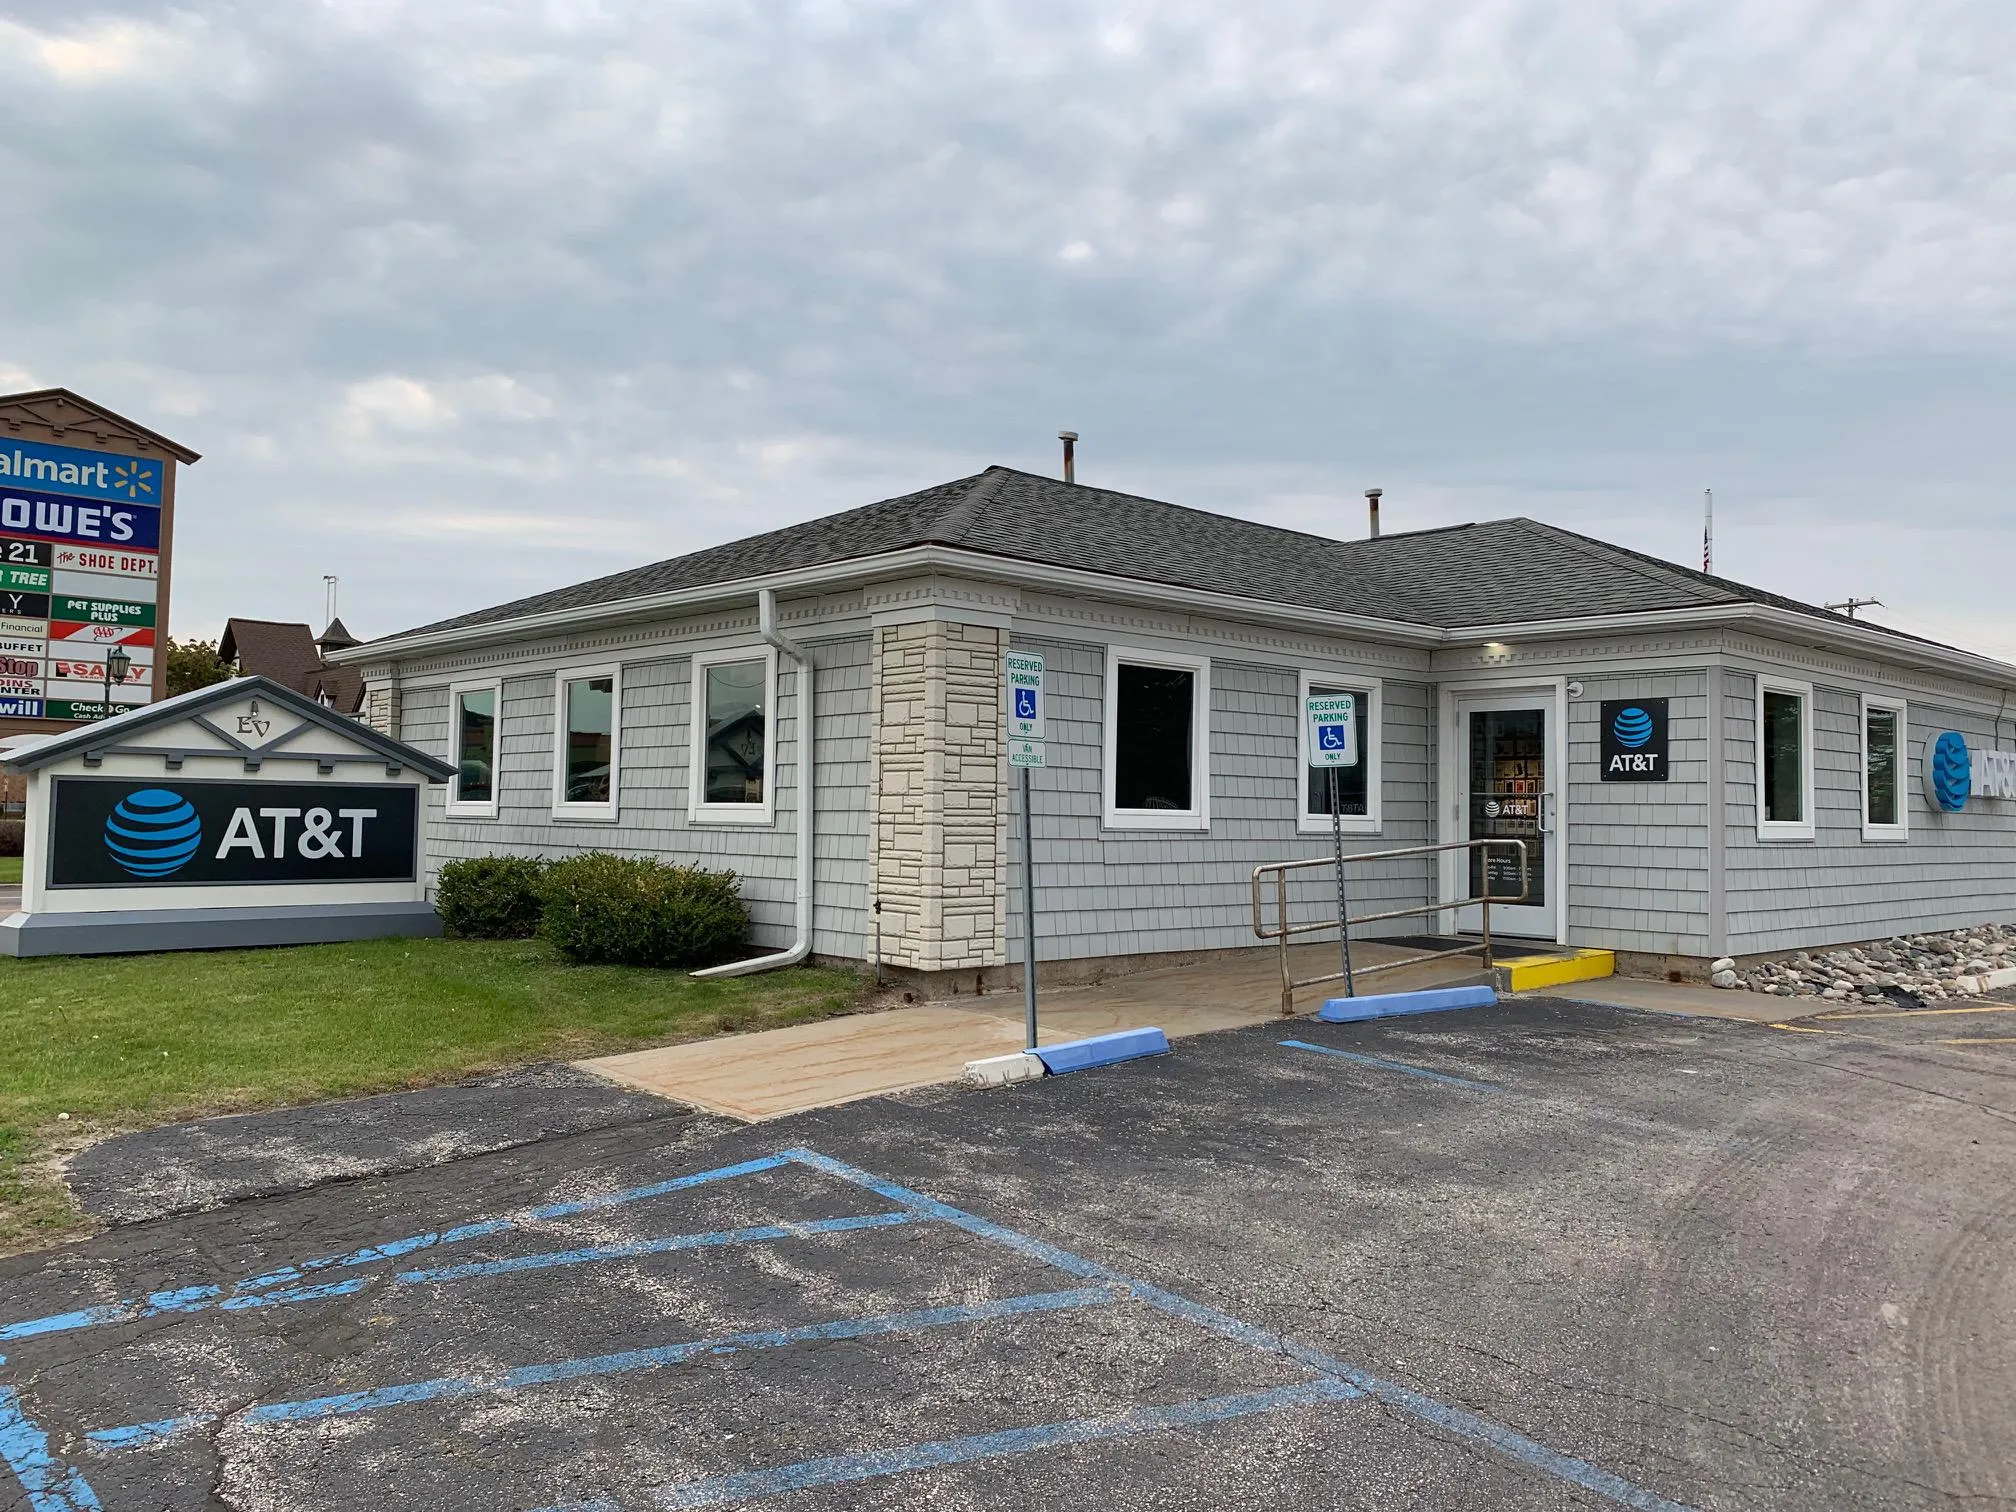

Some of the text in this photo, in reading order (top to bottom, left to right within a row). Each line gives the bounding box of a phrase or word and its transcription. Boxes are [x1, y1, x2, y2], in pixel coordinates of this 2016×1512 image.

[2, 497, 134, 541] OWE'S
[8, 542, 39, 564] 21
[57, 551, 158, 574] the SHOE DEPT.
[10, 571, 48, 586] TREE
[67, 600, 142, 615] PET SUPPLIES
[90, 612, 118, 622] PLUS
[1, 621, 43, 633] Financial
[73, 662, 146, 680] SAY
[1007, 657, 1042, 672] RESERVED
[1010, 672, 1040, 687] PARKING
[70, 702, 104, 713] Check
[1309, 700, 1351, 711] RESERVED
[1313, 712, 1348, 723] PARKING
[1019, 722, 1033, 732] ONLY
[1022, 743, 1033, 753] VAN
[1011, 753, 1043, 764] ACCESSIBLE
[1324, 753, 1341, 761] ONLY
[1608, 753, 1659, 772] AT&T
[1502, 804, 1529, 815] AT&T
[215, 806, 378, 860] AT&T
